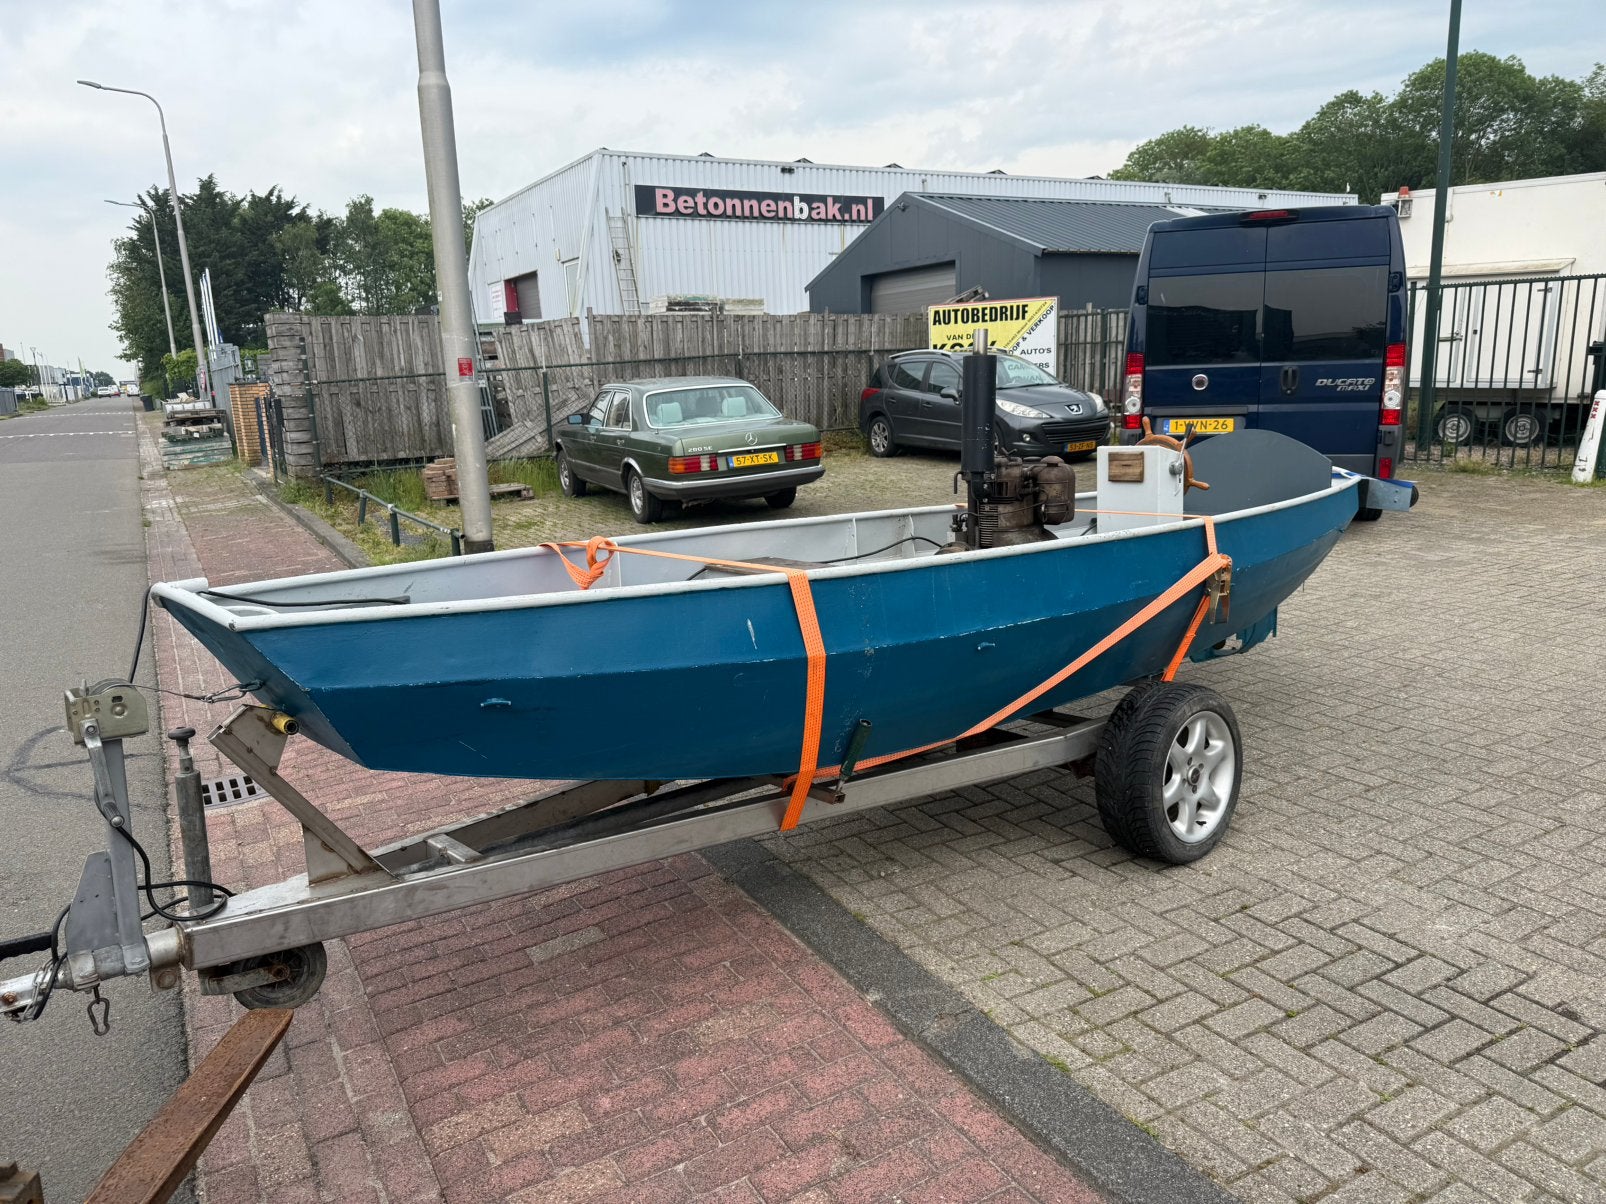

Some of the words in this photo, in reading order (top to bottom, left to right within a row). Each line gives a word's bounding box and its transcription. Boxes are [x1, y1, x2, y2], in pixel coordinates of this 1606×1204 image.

[654, 188, 874, 222] Betonnenbak.nl
[932, 304, 1029, 326] AUTOBEDRIJF
[1026, 304, 1055, 336] VERKOOP
[946, 333, 964, 341] VAN
[1315, 377, 1376, 386] DUCATO
[736, 453, 776, 466] 57-XT-SK
